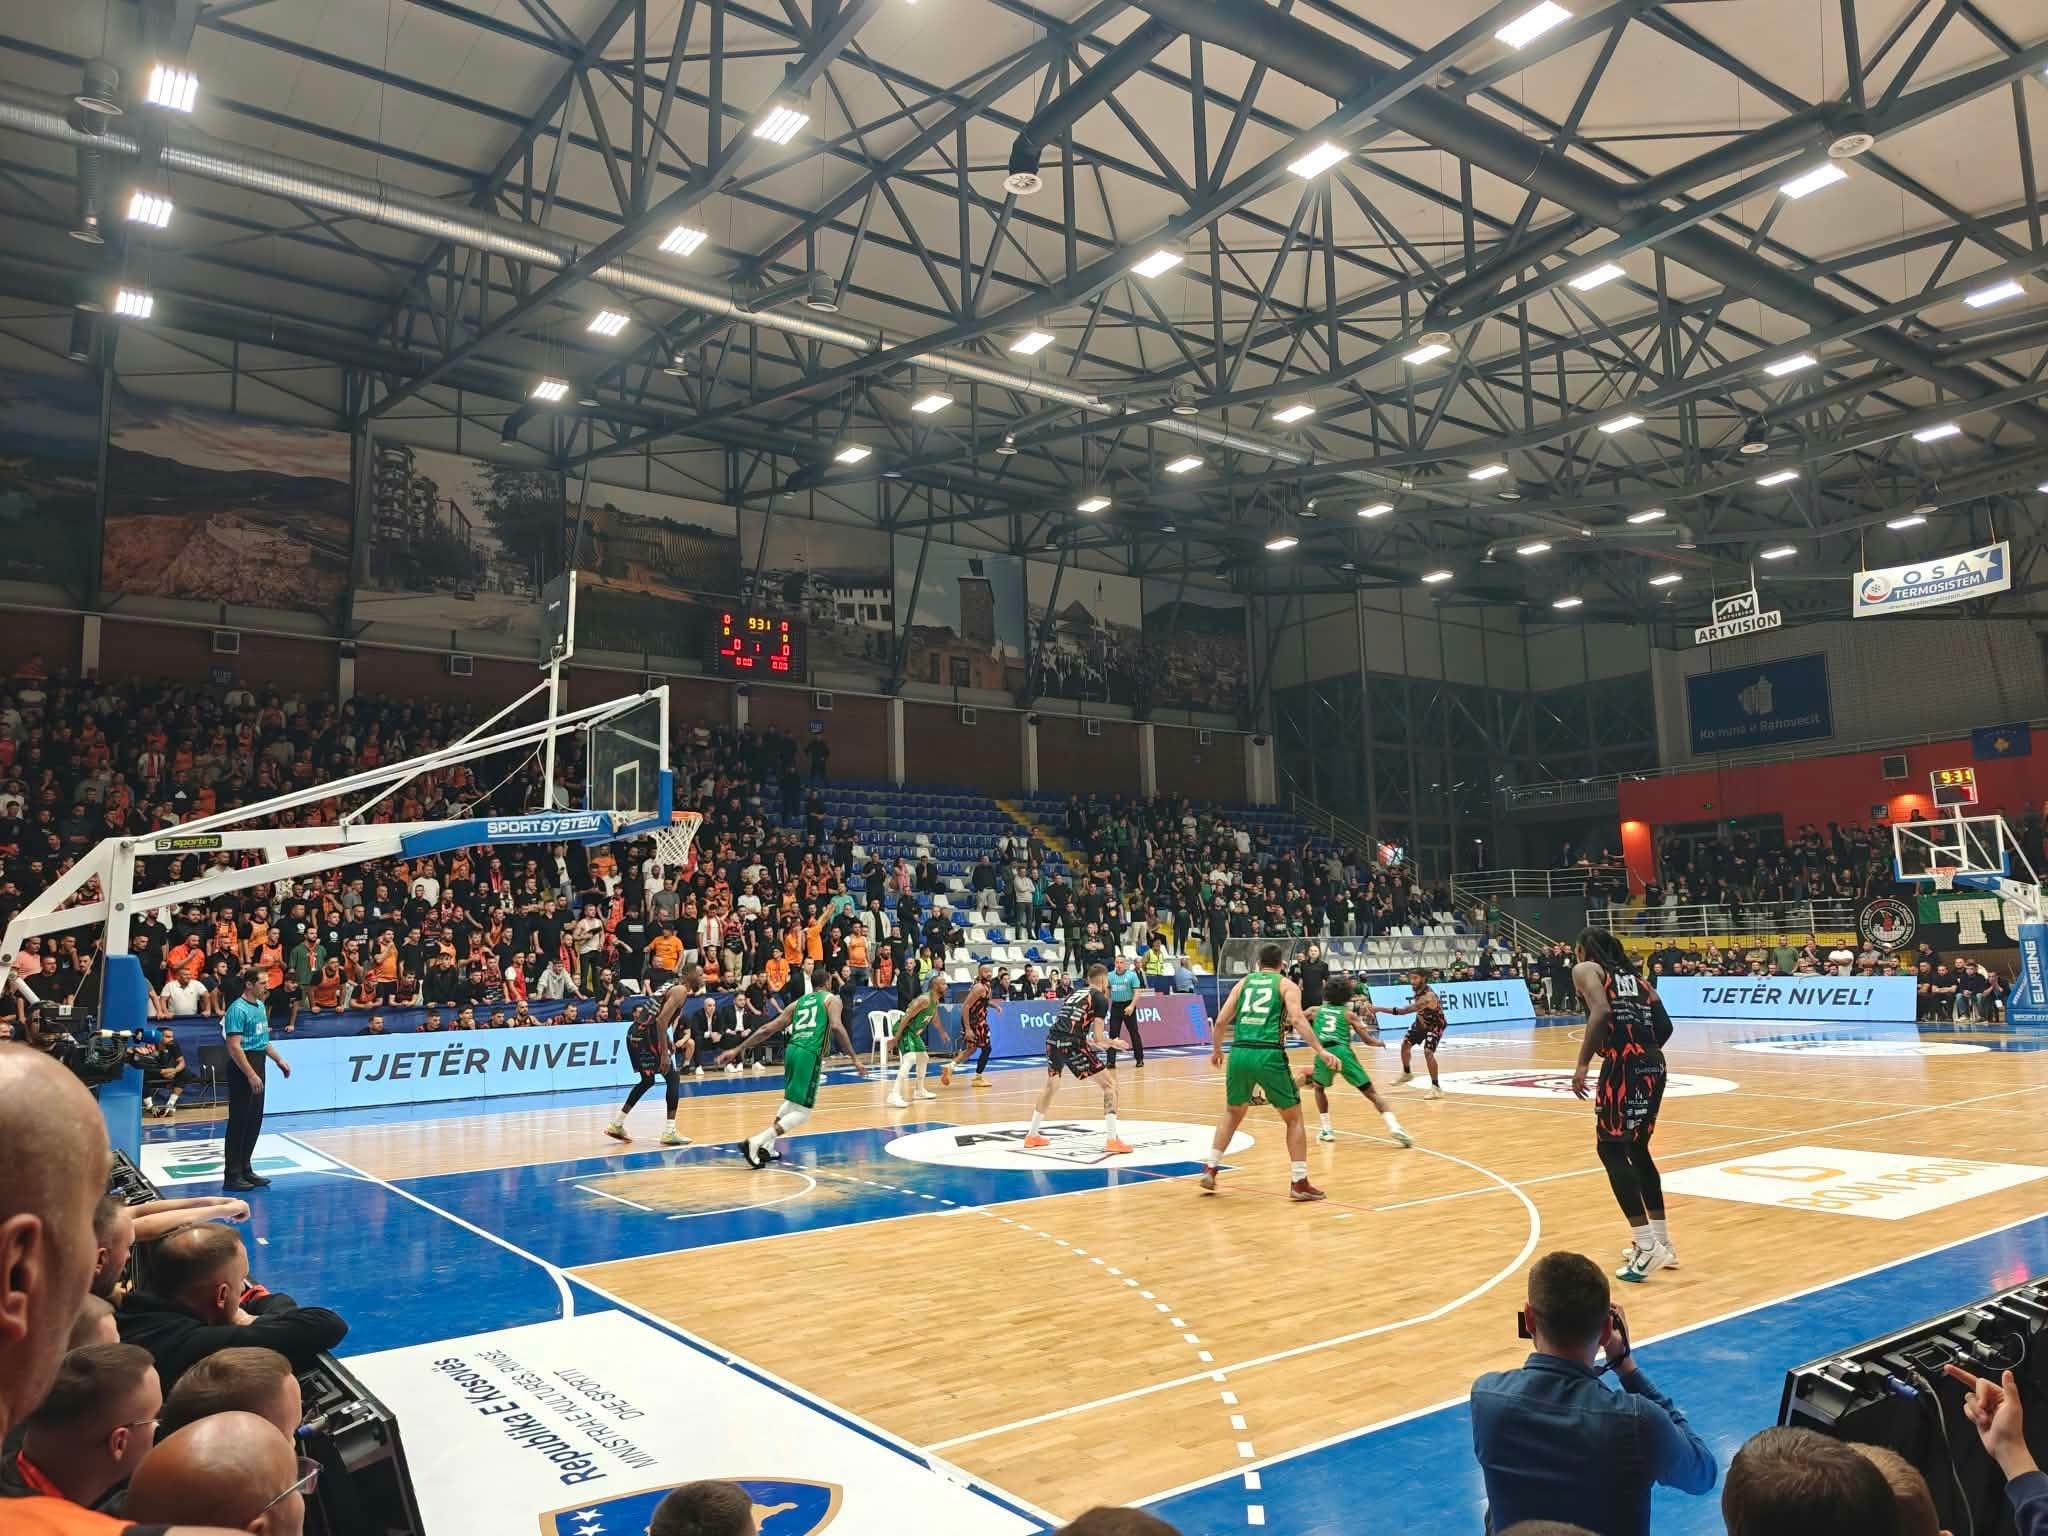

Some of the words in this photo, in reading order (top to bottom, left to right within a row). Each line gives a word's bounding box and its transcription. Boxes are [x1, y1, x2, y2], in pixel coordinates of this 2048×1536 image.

[1893, 574, 1981, 600] TERMOSISTEM
[1698, 613, 1778, 643] ARTVISION
[487, 815, 601, 834] SPORTSYSTEM
[173, 837, 219, 847] sporting
[1240, 987, 1273, 1014] 12
[1462, 990, 1509, 1010] NIVEL!
[1701, 983, 1782, 1005] TJETËR
[1788, 987, 1875, 1006] NIVEL!
[794, 1005, 818, 1031] 21
[1321, 1014, 1338, 1033] 3
[348, 1042, 490, 1083] TJETËR
[501, 1039, 621, 1073] NIVEL!
[431, 1356, 507, 1405] Kosovës
[552, 1368, 616, 1402] SPORTIT
[478, 1400, 521, 1416] E
[601, 1399, 646, 1421] DHE
[503, 1411, 608, 1486] Republika
[576, 1418, 659, 1470] MINISTRIA
